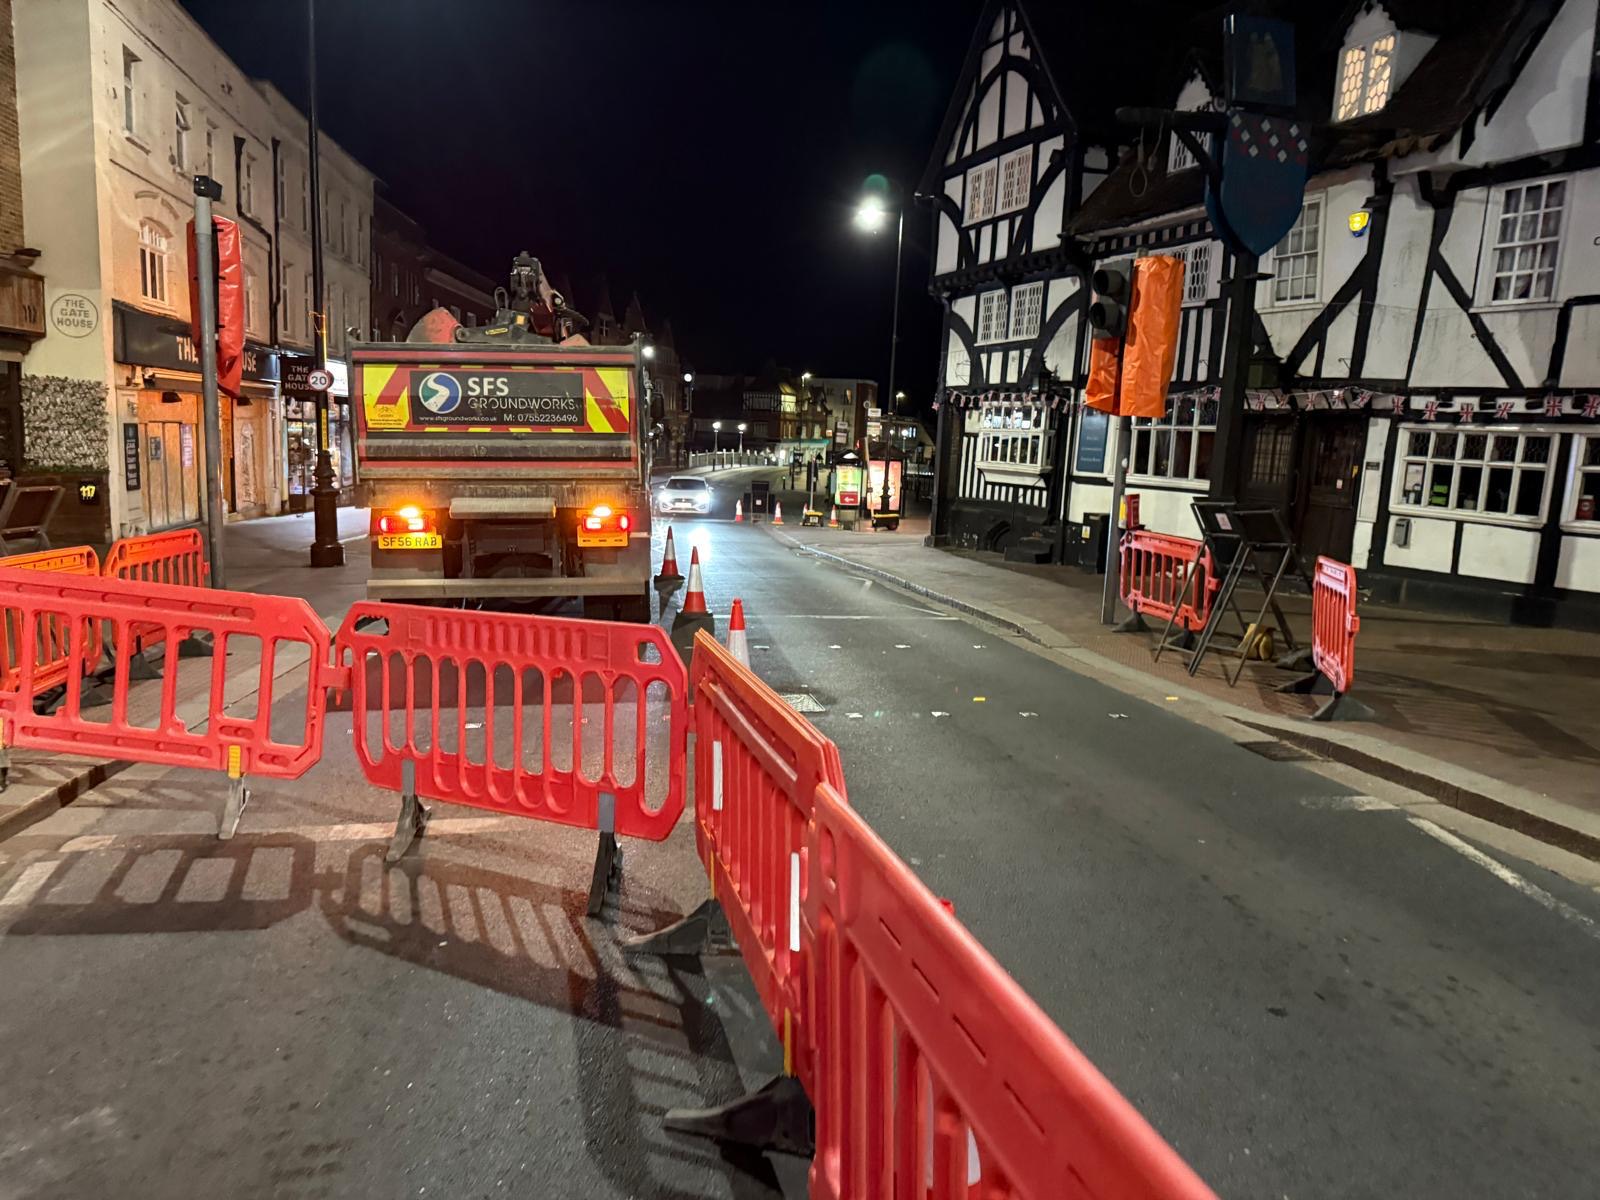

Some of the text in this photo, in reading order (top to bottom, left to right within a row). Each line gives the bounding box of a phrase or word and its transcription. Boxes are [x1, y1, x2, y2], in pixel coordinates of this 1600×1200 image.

[64, 298, 85, 309] THE
[60, 308, 90, 318] GATE
[56, 317, 93, 329] HOUSE
[291, 365, 309, 373] THE
[287, 374, 307, 382] GAT
[311, 375, 327, 386] 20
[284, 382, 311, 391] HOUS
[467, 377, 509, 396] SFS
[467, 397, 575, 410] GROUNDWORKS
[503, 414, 578, 423] M: 07552236496
[382, 537, 411, 547] SF56
